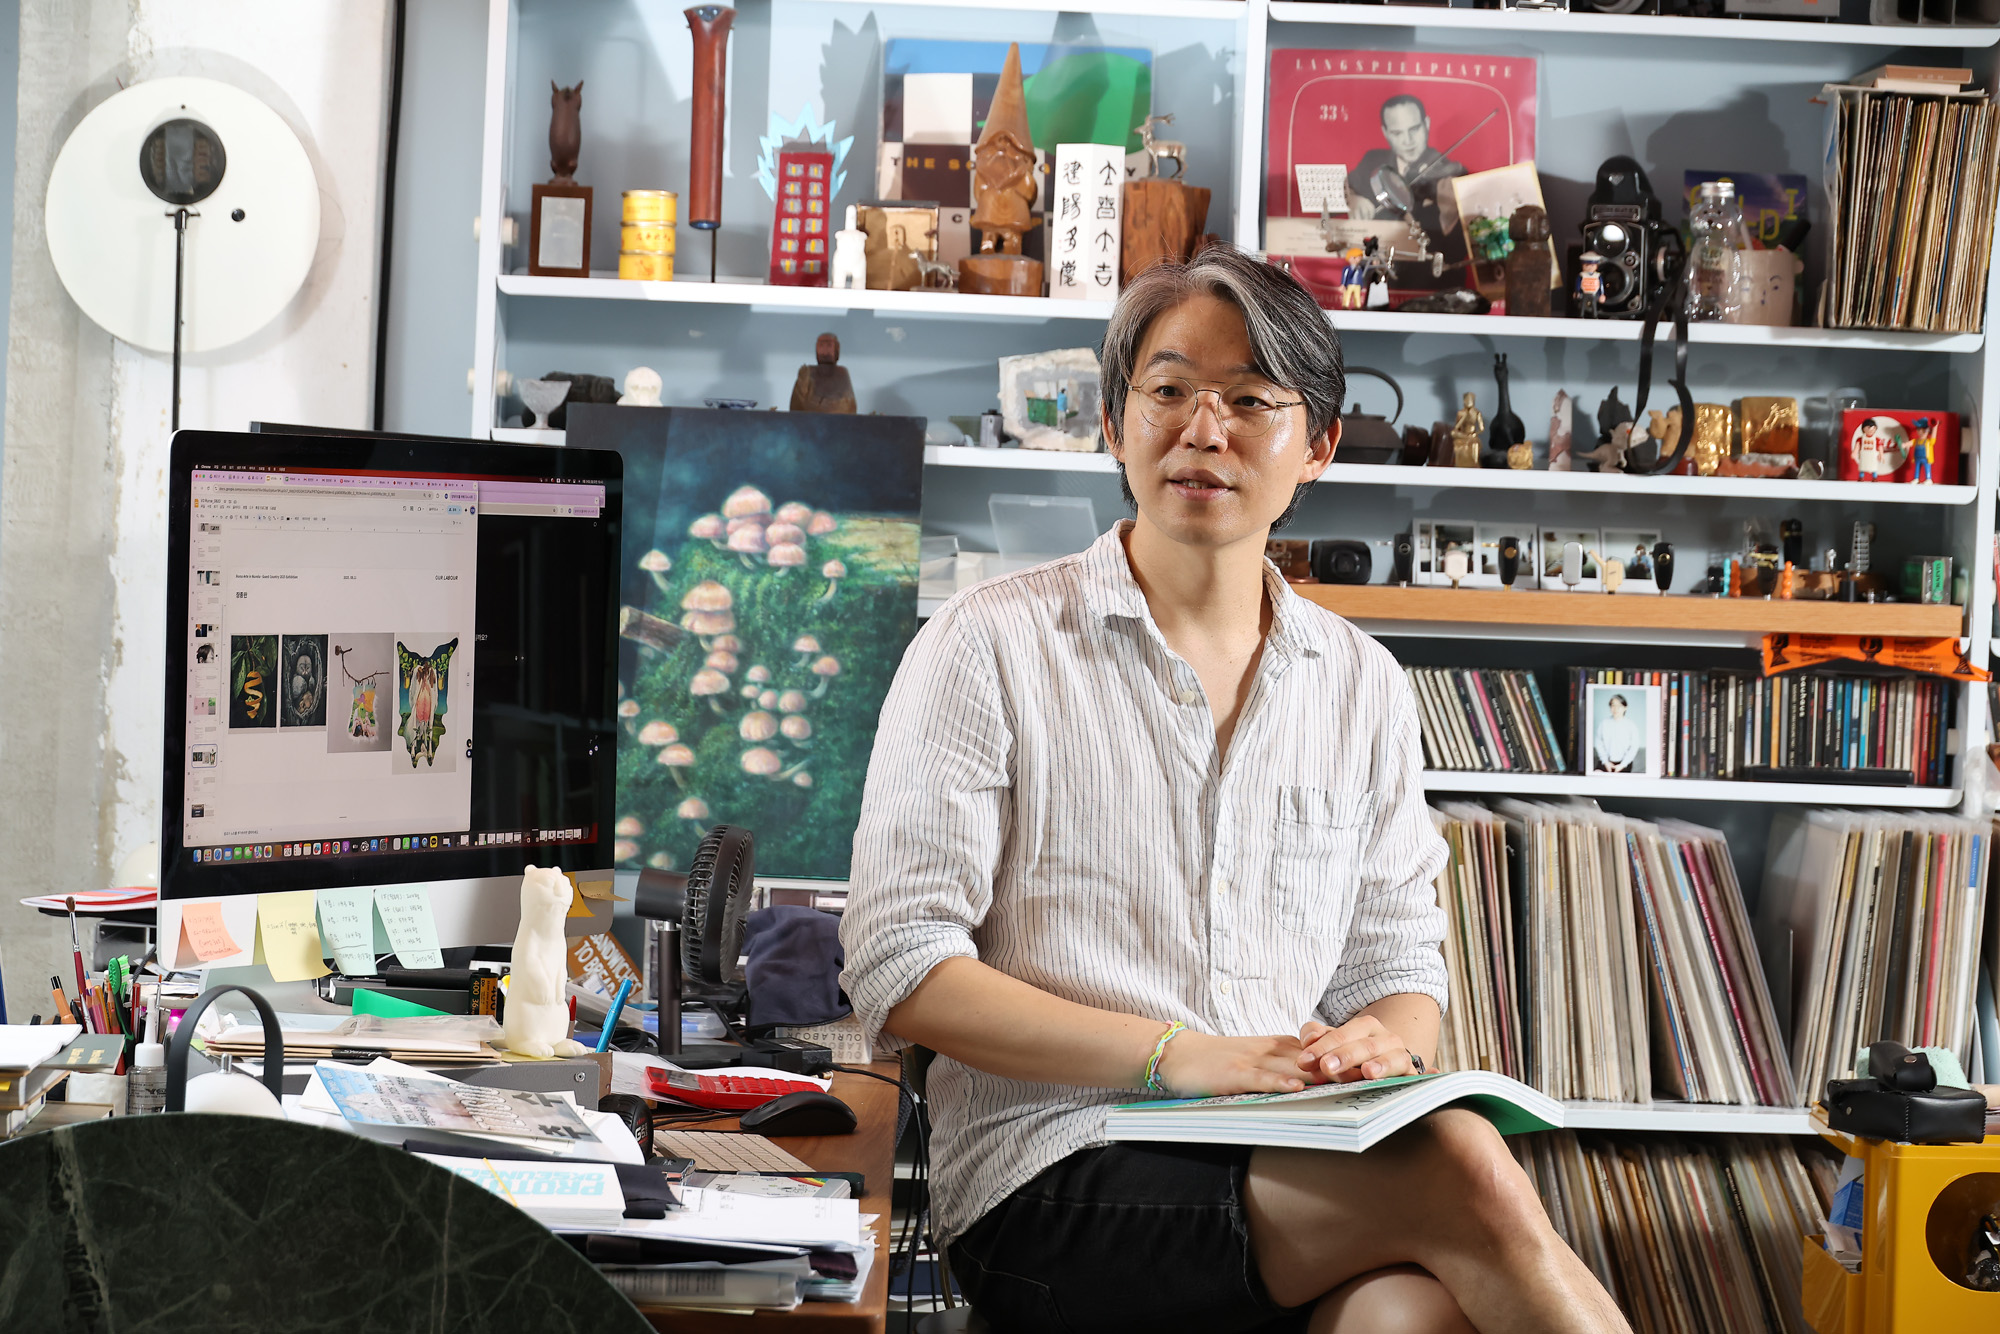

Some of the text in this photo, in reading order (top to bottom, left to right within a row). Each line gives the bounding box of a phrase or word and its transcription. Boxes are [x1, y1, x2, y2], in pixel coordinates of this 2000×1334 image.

[1296, 58, 1512, 78] LANGSPIELPLATTE
[1799, 675, 1807, 718] bauhaus
[574, 940, 594, 963] TO
[472, 999, 479, 1008] 36
